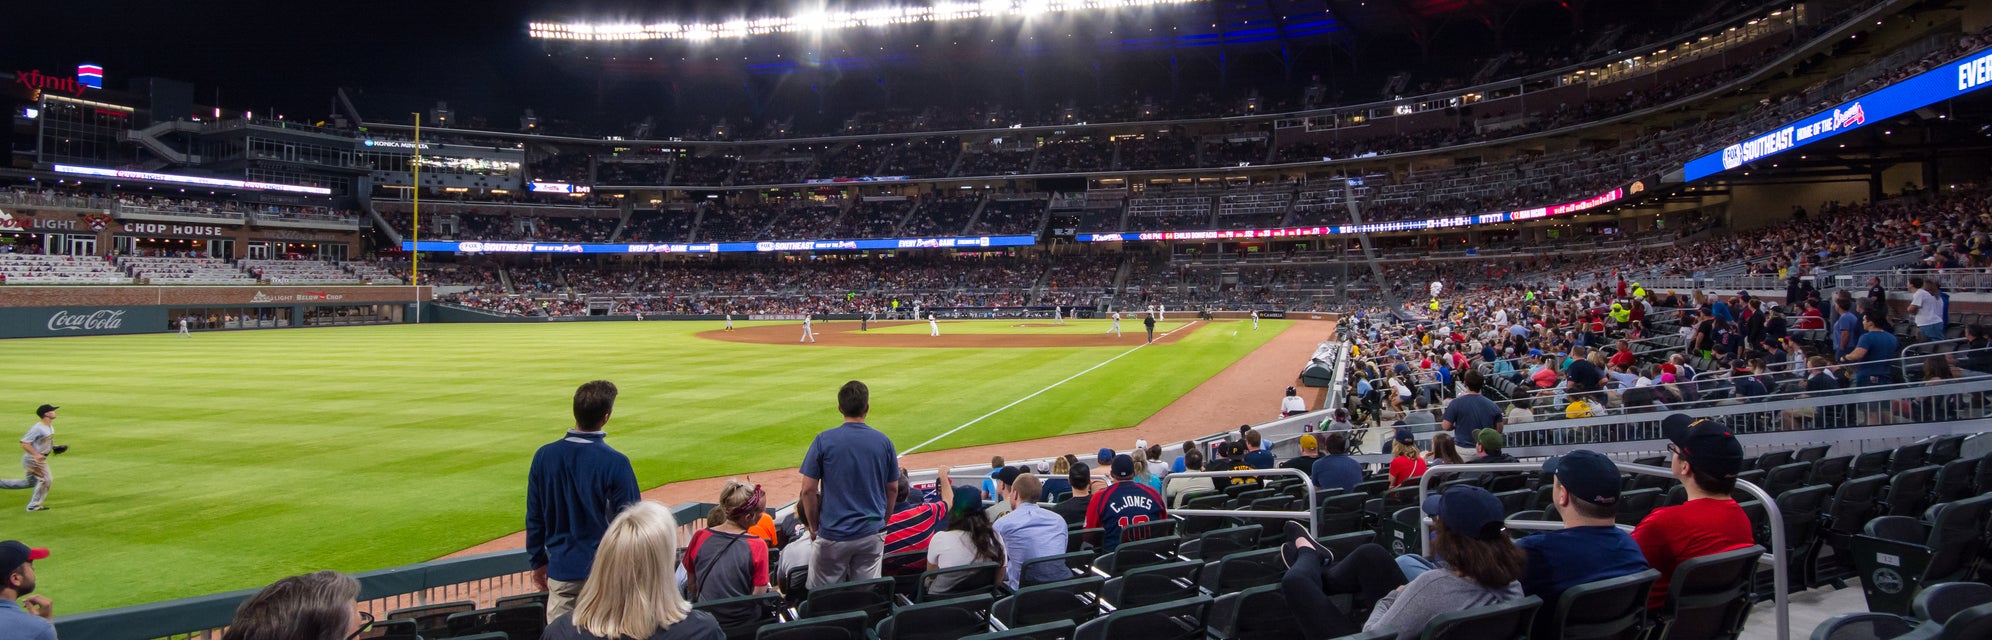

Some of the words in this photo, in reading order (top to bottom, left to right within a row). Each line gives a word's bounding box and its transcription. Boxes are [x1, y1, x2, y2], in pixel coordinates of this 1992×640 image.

[16, 69, 88, 96] xfinity
[1742, 126, 1795, 162] SOUTHEAST
[1796, 127, 1813, 142] HOME
[1813, 124, 1821, 136] OF
[1821, 117, 1833, 133] THE
[33, 218, 76, 230] LIGHT
[124, 222, 167, 233] CHOP
[173, 225, 222, 236] HOUSE
[483, 243, 534, 252] SOUTHEAST
[774, 242, 815, 250] SOUTHEAST
[47, 309, 126, 331] Coca-Cola
[1110, 495, 1153, 513] C.JONES
